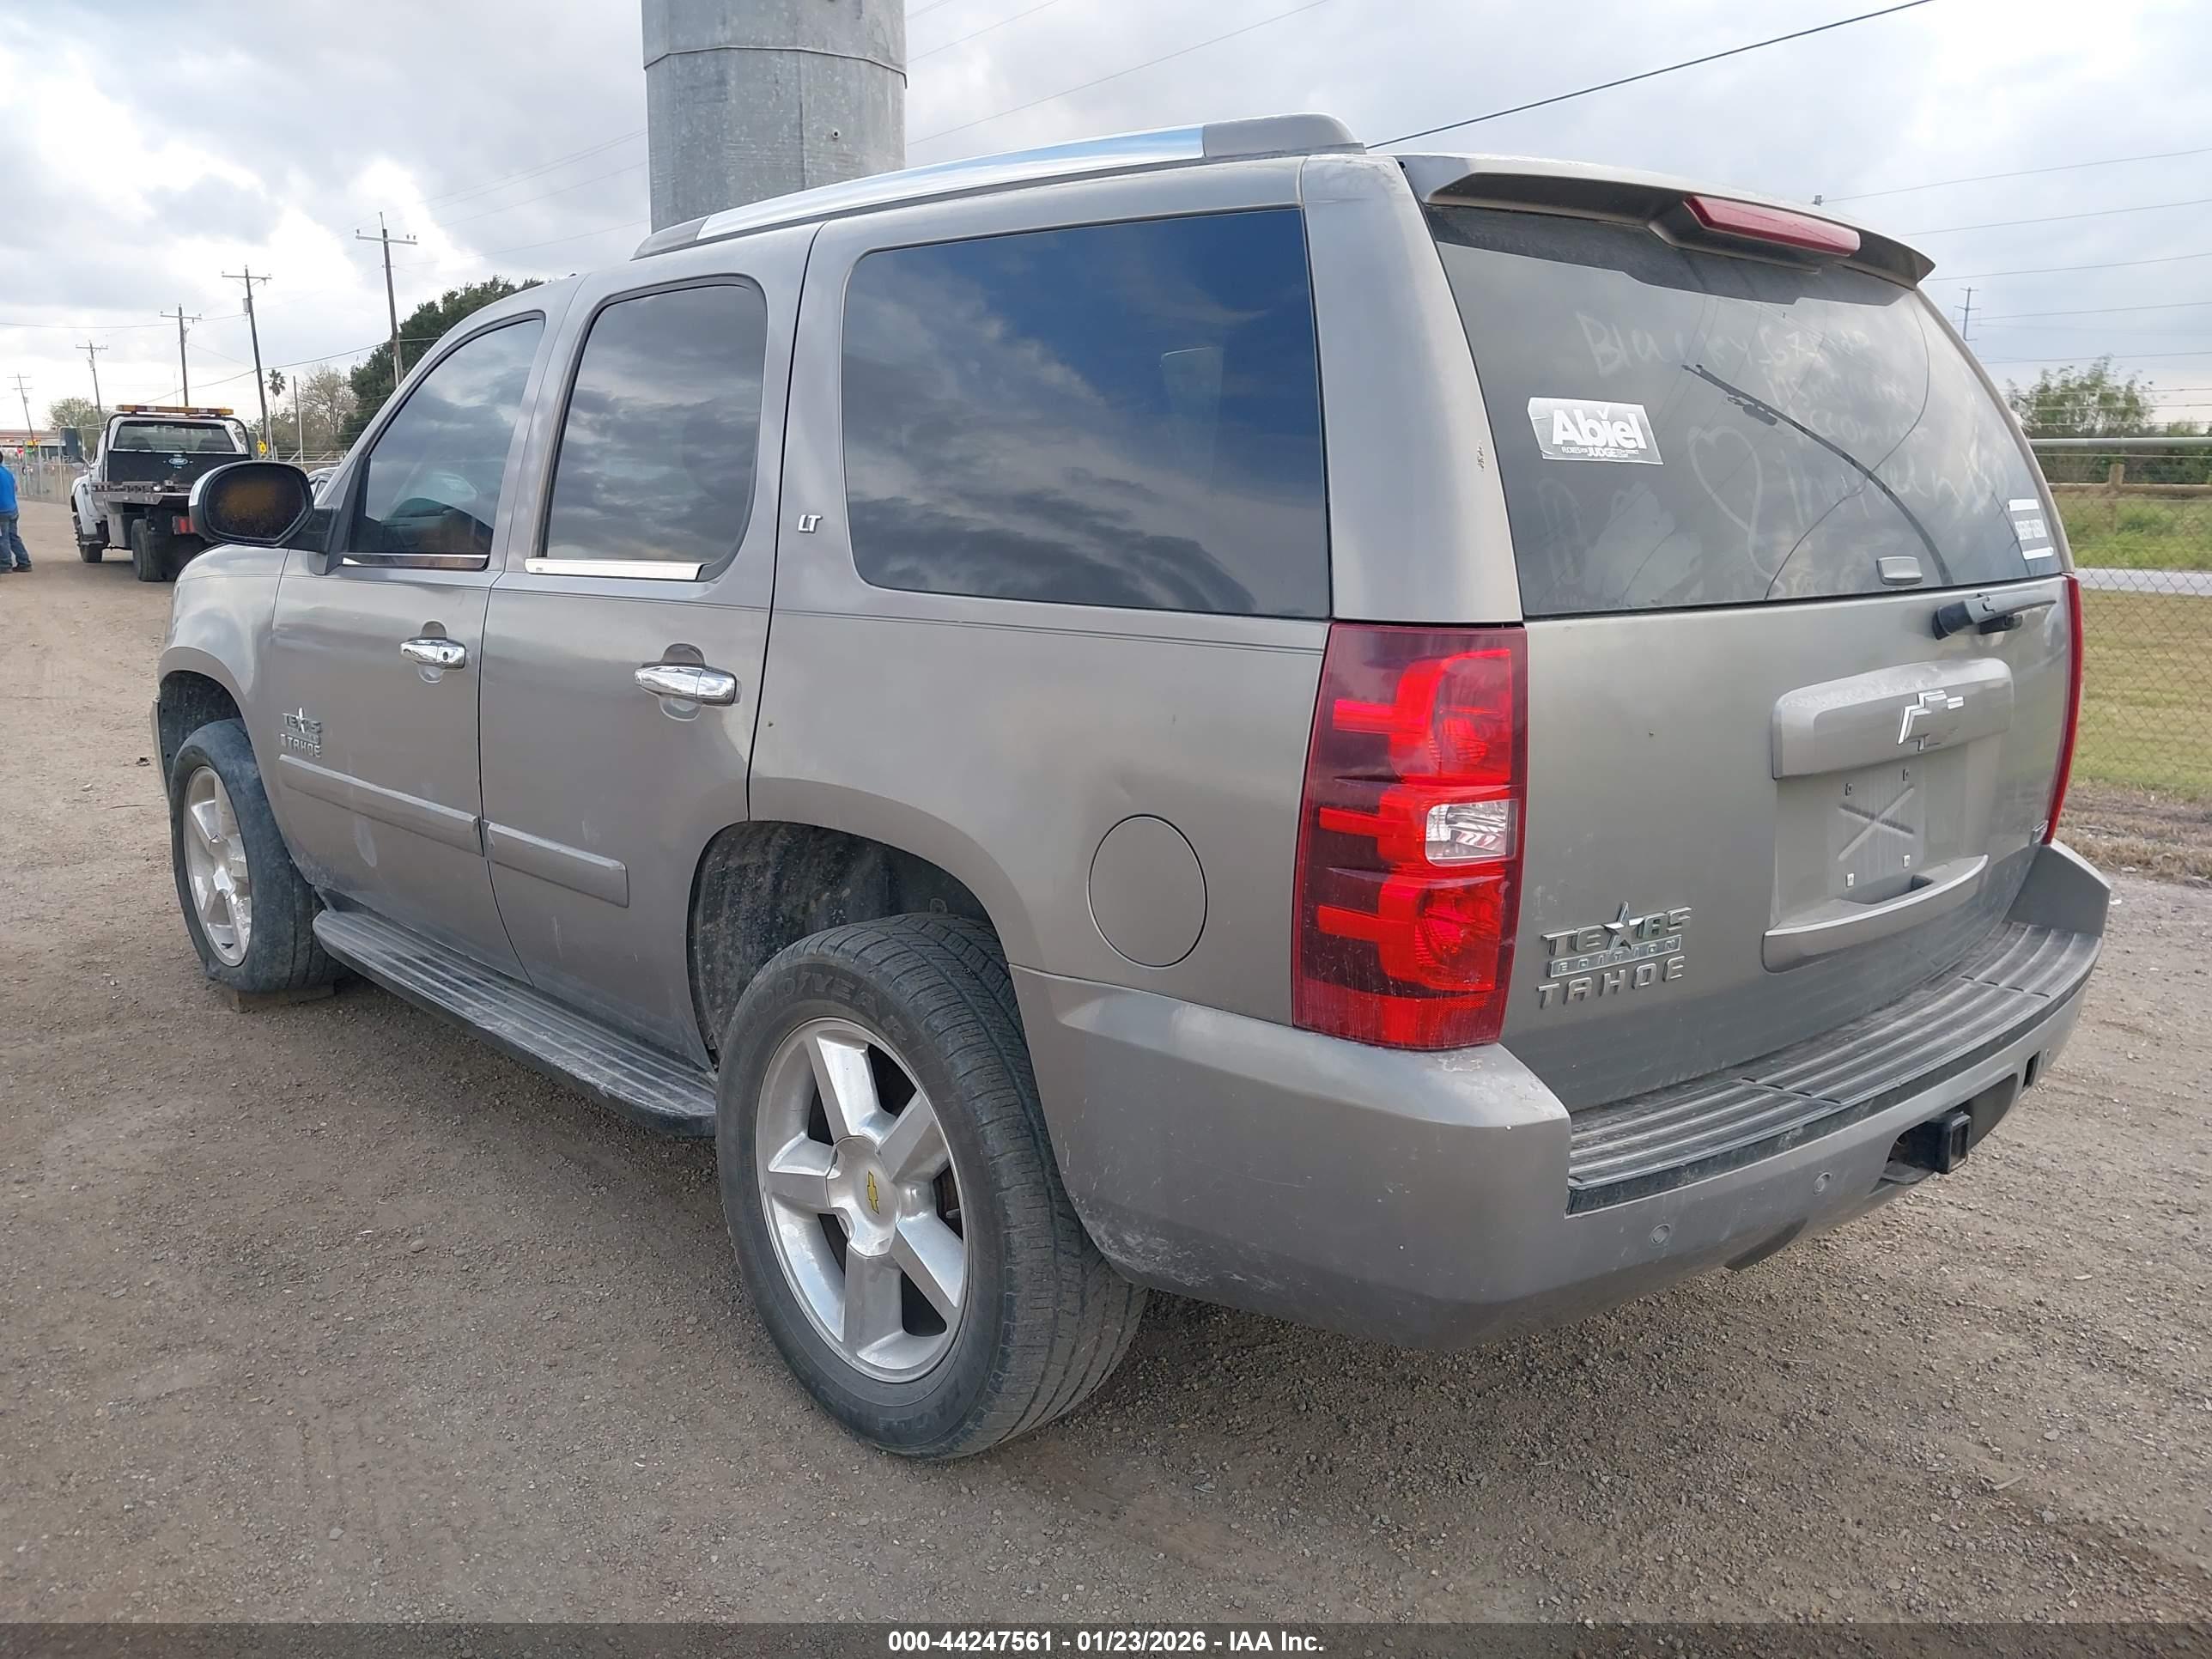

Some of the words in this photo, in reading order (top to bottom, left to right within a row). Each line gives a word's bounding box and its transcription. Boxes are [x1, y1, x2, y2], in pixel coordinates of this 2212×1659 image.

[1552, 405, 1648, 449] Abiel
[1587, 447, 1617, 458] JUDGE
[798, 514, 823, 533] LT
[287, 737, 322, 758] TAHOE
[1540, 902, 1692, 955] TEXAS
[1556, 938, 1679, 973] EDITION
[1537, 955, 1686, 1009] TAHOE
